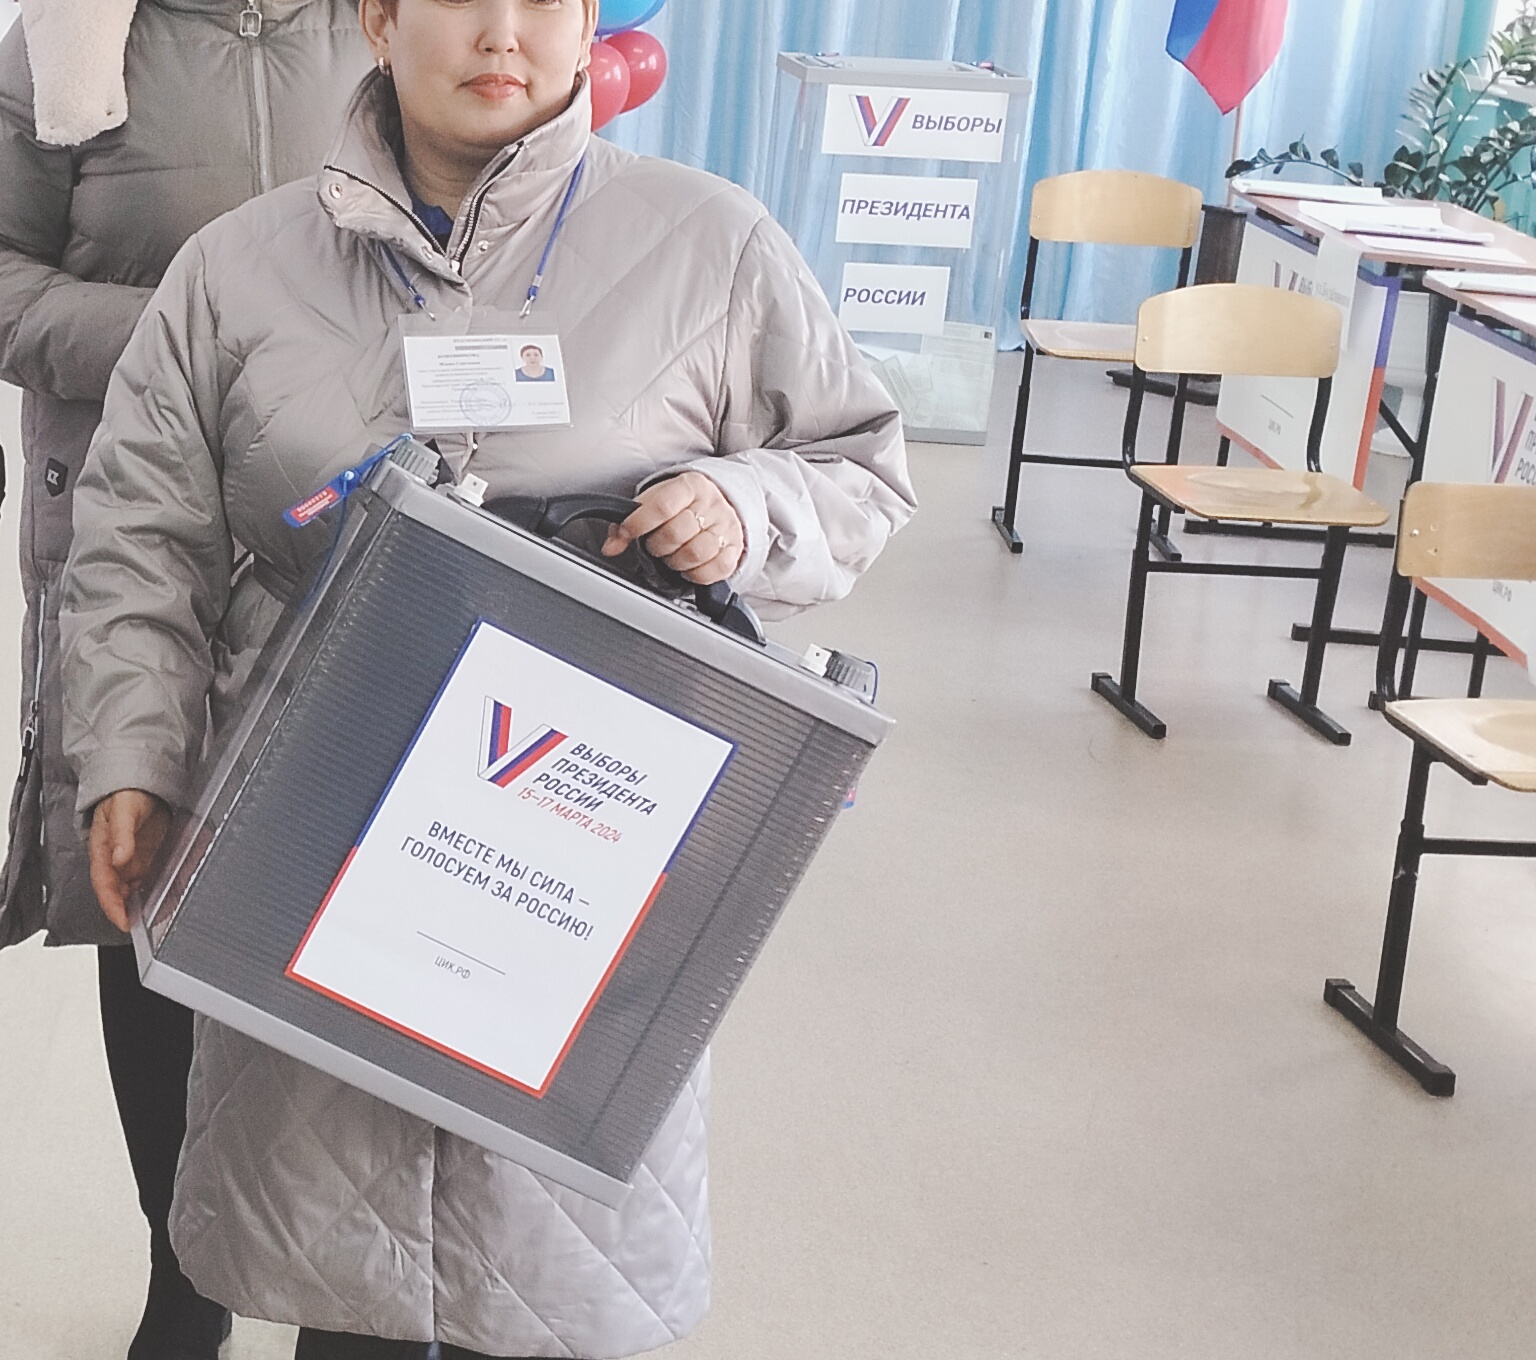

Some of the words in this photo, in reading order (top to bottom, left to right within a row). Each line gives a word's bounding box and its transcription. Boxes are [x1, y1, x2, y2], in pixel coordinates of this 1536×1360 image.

[911, 114, 1003, 134] ВЫБОРЫ
[840, 198, 972, 221] ПРЕЗИДЕНТА
[843, 287, 927, 306] РОССИИ
[569, 743, 648, 786] ВЫБОРЫ
[532, 772, 604, 812] РОССИИ
[551, 758, 658, 816] ПРЕЗИДЕНТА
[549, 802, 594, 829] МАРТА
[590, 822, 623, 844] 2024
[427, 821, 496, 865] ВМЕСТЕ
[495, 853, 529, 881] МЫ
[529, 871, 575, 904] СИЛА
[400, 836, 491, 890] ГОЛОСУЕМ
[490, 880, 513, 903] ЗА
[514, 891, 594, 941] РОССИЮ!
[434, 955, 472, 979] ЦИК.РФ
